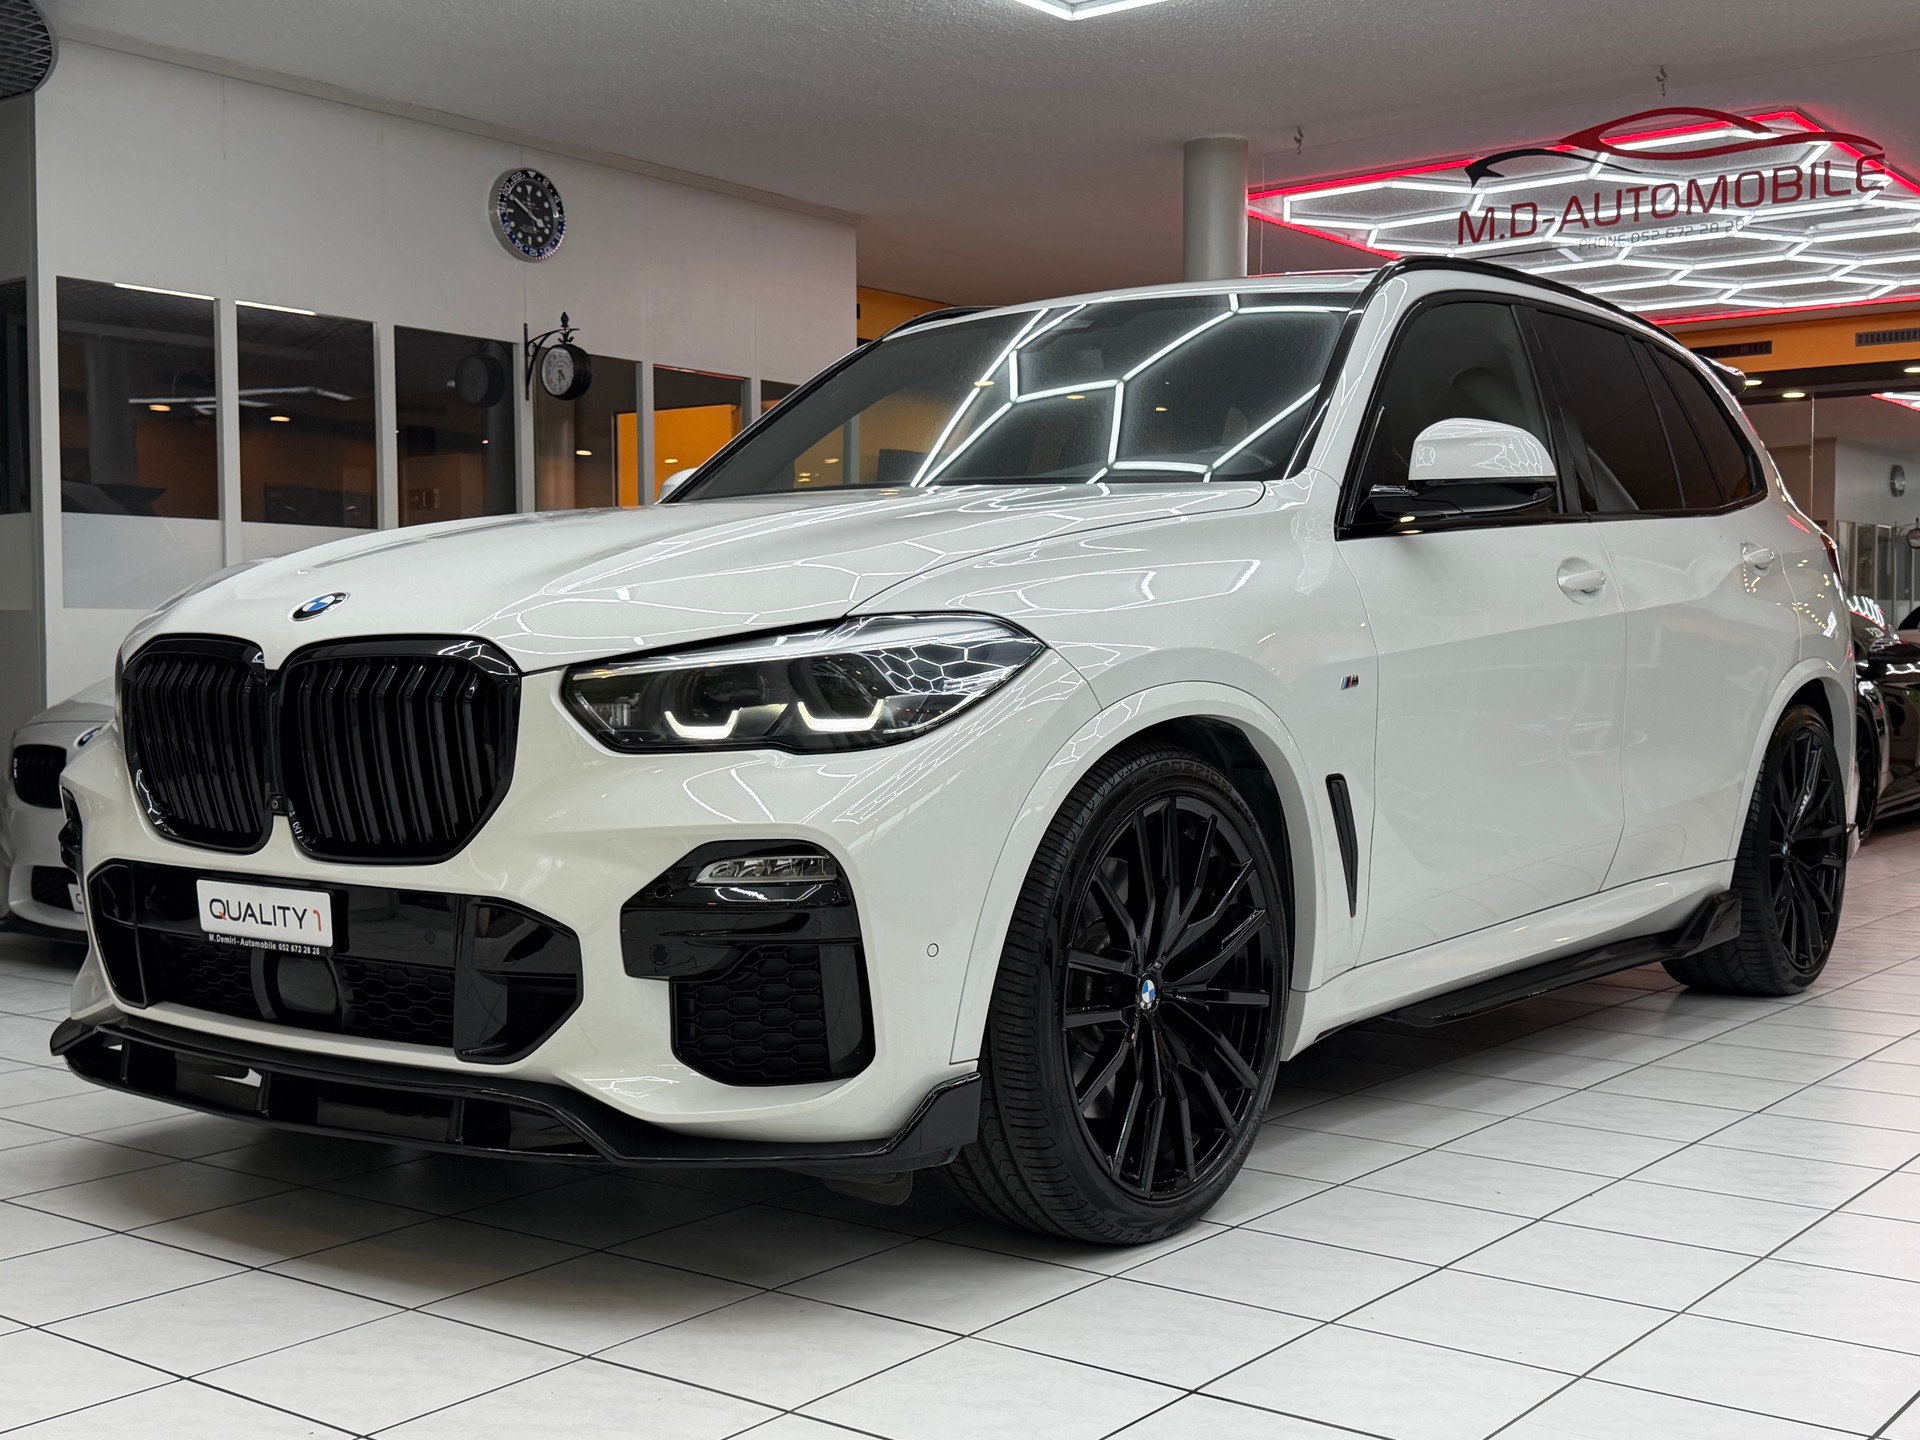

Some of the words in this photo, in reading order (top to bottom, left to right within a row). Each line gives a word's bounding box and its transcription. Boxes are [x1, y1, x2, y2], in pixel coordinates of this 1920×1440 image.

[1457, 152, 1886, 245] M.D-AUTOMOBILE
[1578, 233, 1625, 250] PHONE
[1630, 229, 1660, 243] 052
[1665, 225, 1693, 239] 672
[1700, 222, 1719, 233] 28
[1725, 218, 1746, 232] 28
[209, 898, 308, 930] QUALITY
[278, 943, 290, 952] 052
[291, 944, 302, 953] 672
[303, 945, 311, 954] 28
[312, 947, 320, 955] 28
